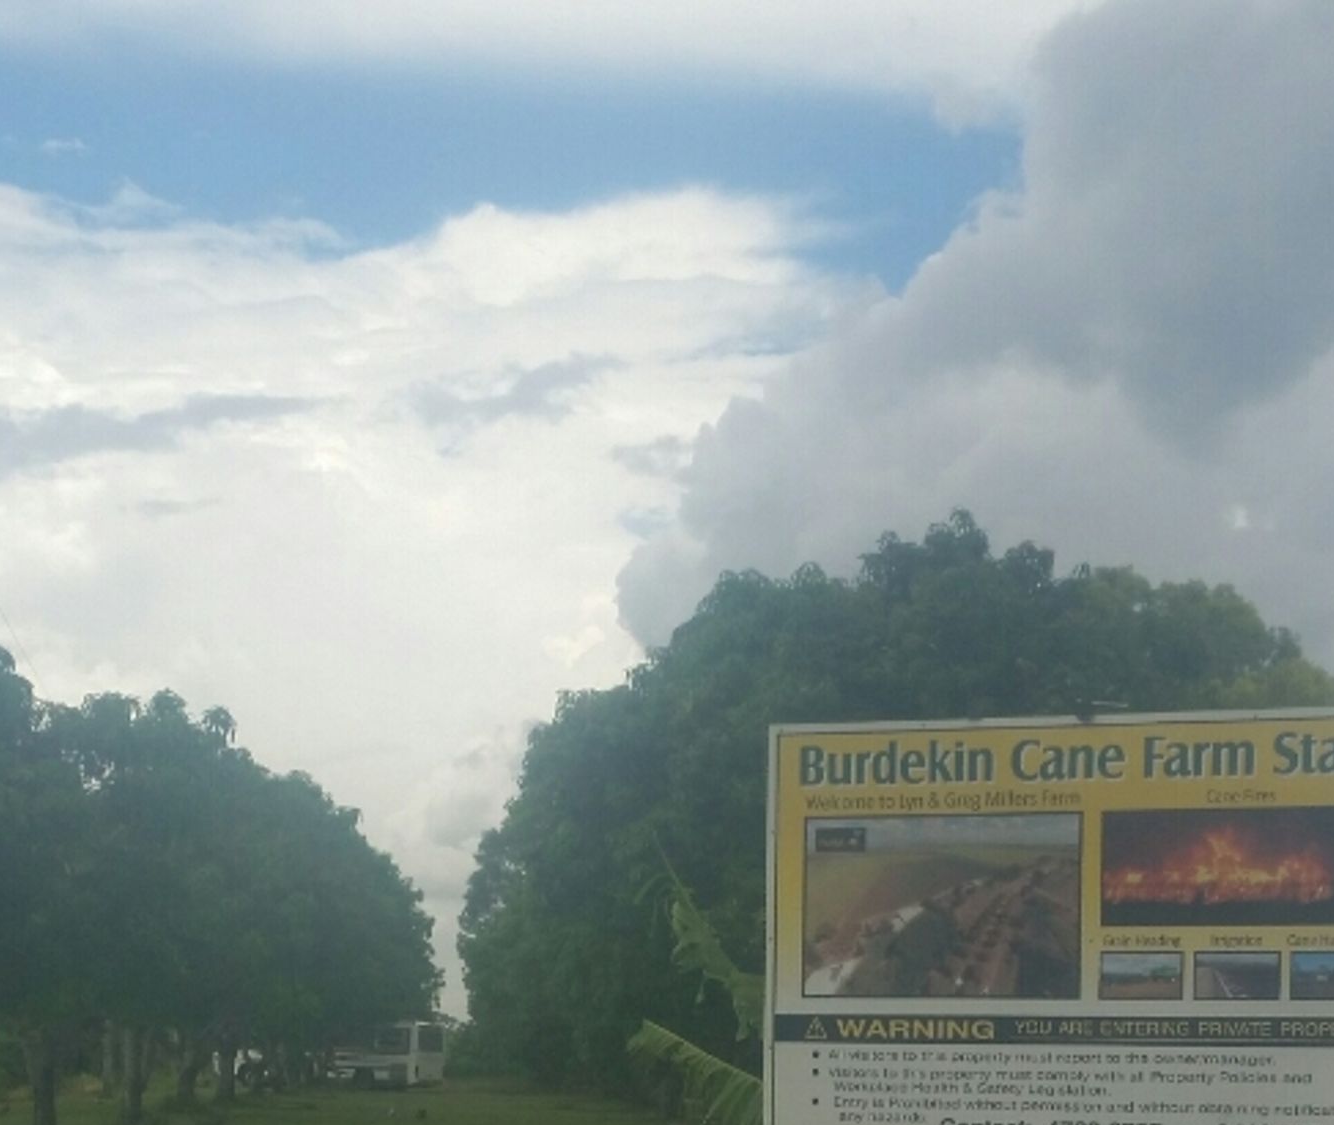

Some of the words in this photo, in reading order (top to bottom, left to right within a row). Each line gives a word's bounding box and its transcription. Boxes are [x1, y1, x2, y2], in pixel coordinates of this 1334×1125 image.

[799, 739, 994, 786] Burdekin
[1011, 738, 1126, 782] Cane
[1143, 736, 1255, 779] Farm
[806, 795, 874, 810] Welcome
[878, 796, 894, 809] to
[928, 793, 942, 809] &
[944, 792, 980, 811] Greg
[1042, 790, 1081, 806] Farm
[836, 1019, 995, 1040] WARNING
[1015, 1020, 1053, 1035] YOU
[1058, 1021, 1093, 1036] ARE
[1099, 1021, 1189, 1036] ENTERING
[1198, 1021, 1271, 1037] PRIVATE
[963, 1082, 972, 1094] &
